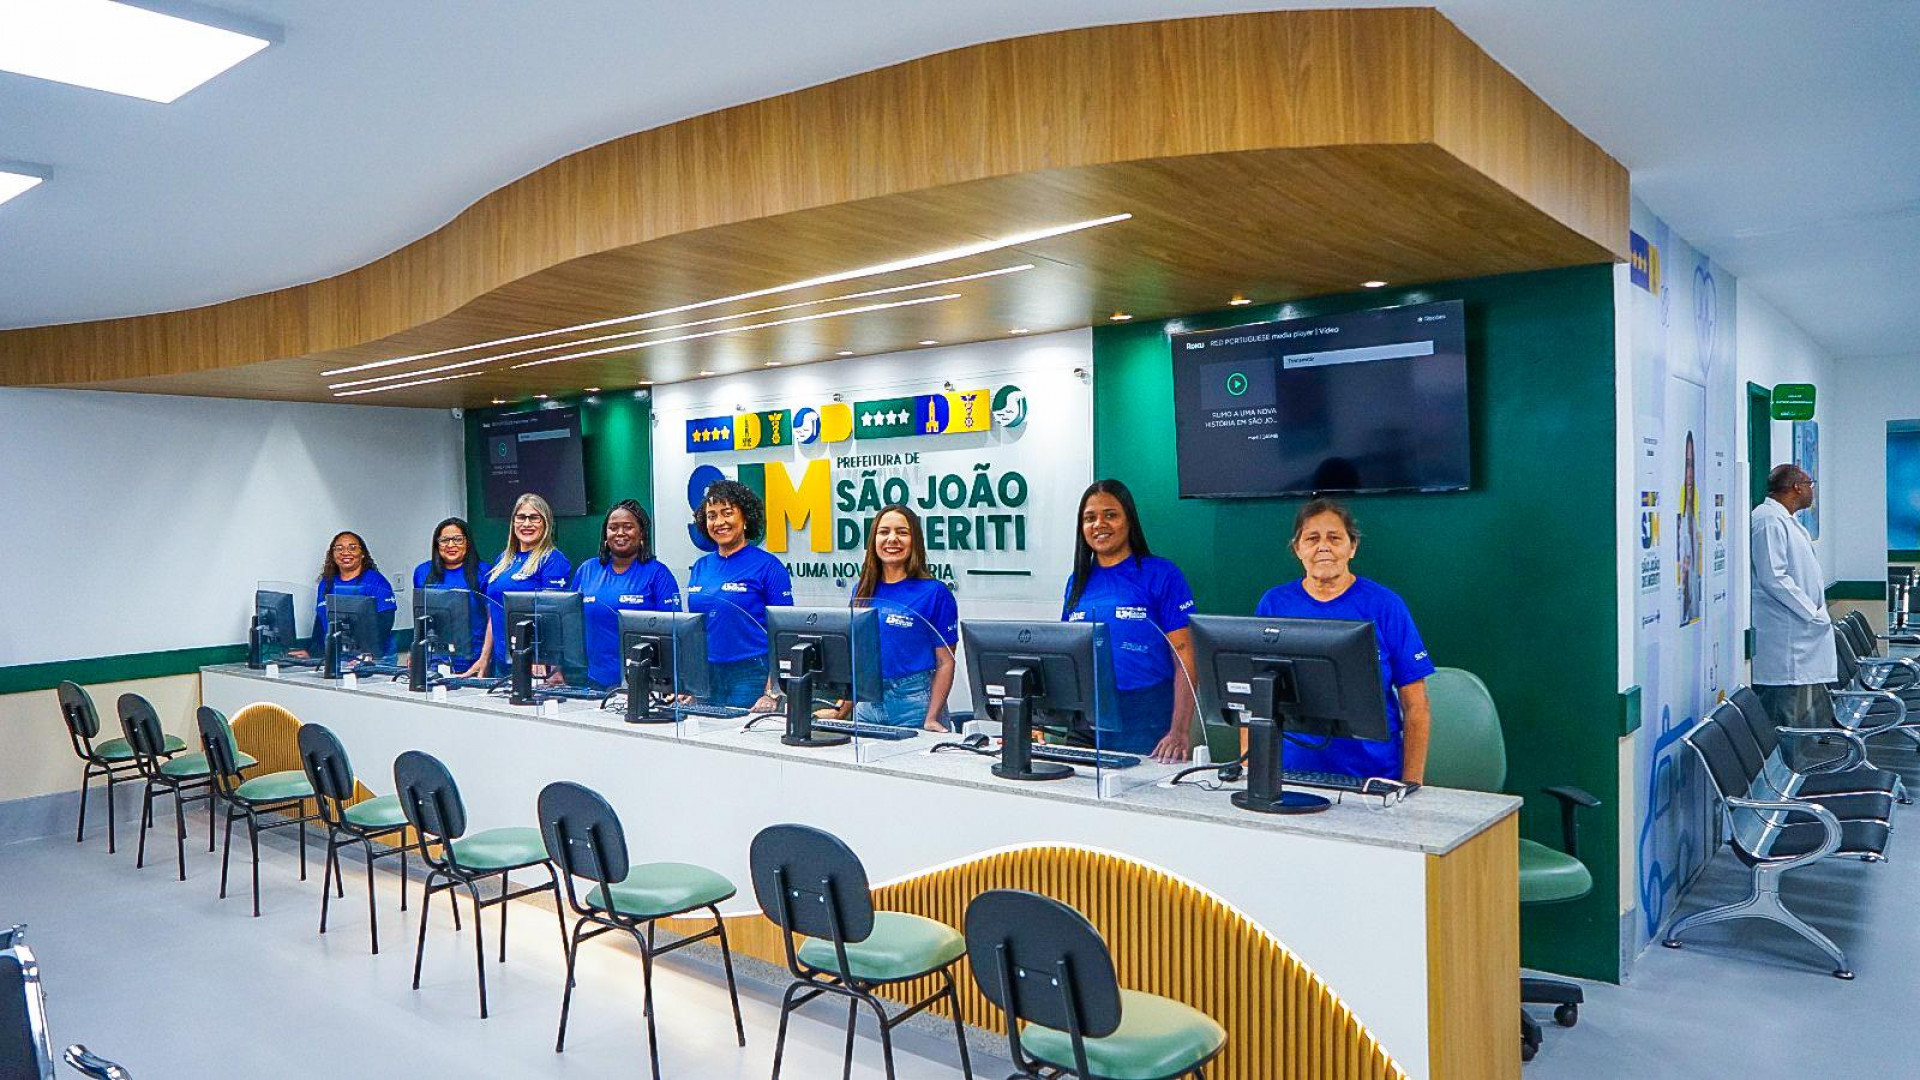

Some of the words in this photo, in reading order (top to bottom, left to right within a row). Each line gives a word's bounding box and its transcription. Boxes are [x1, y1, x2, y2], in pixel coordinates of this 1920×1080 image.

[1224, 334, 1271, 346] PORTUGUESE
[1271, 330, 1293, 340] media
[1293, 328, 1314, 340] player
[1240, 409, 1256, 417] UMA
[1257, 407, 1277, 415] NOVA
[1236, 418, 1247, 426] EM
[837, 453, 902, 468] PREFEITURA
[905, 451, 920, 465] DE
[836, 470, 910, 512] SÃO
[917, 462, 1028, 510] JOÃO
[919, 514, 1026, 551] ERITI
[796, 562, 828, 577] UMA
